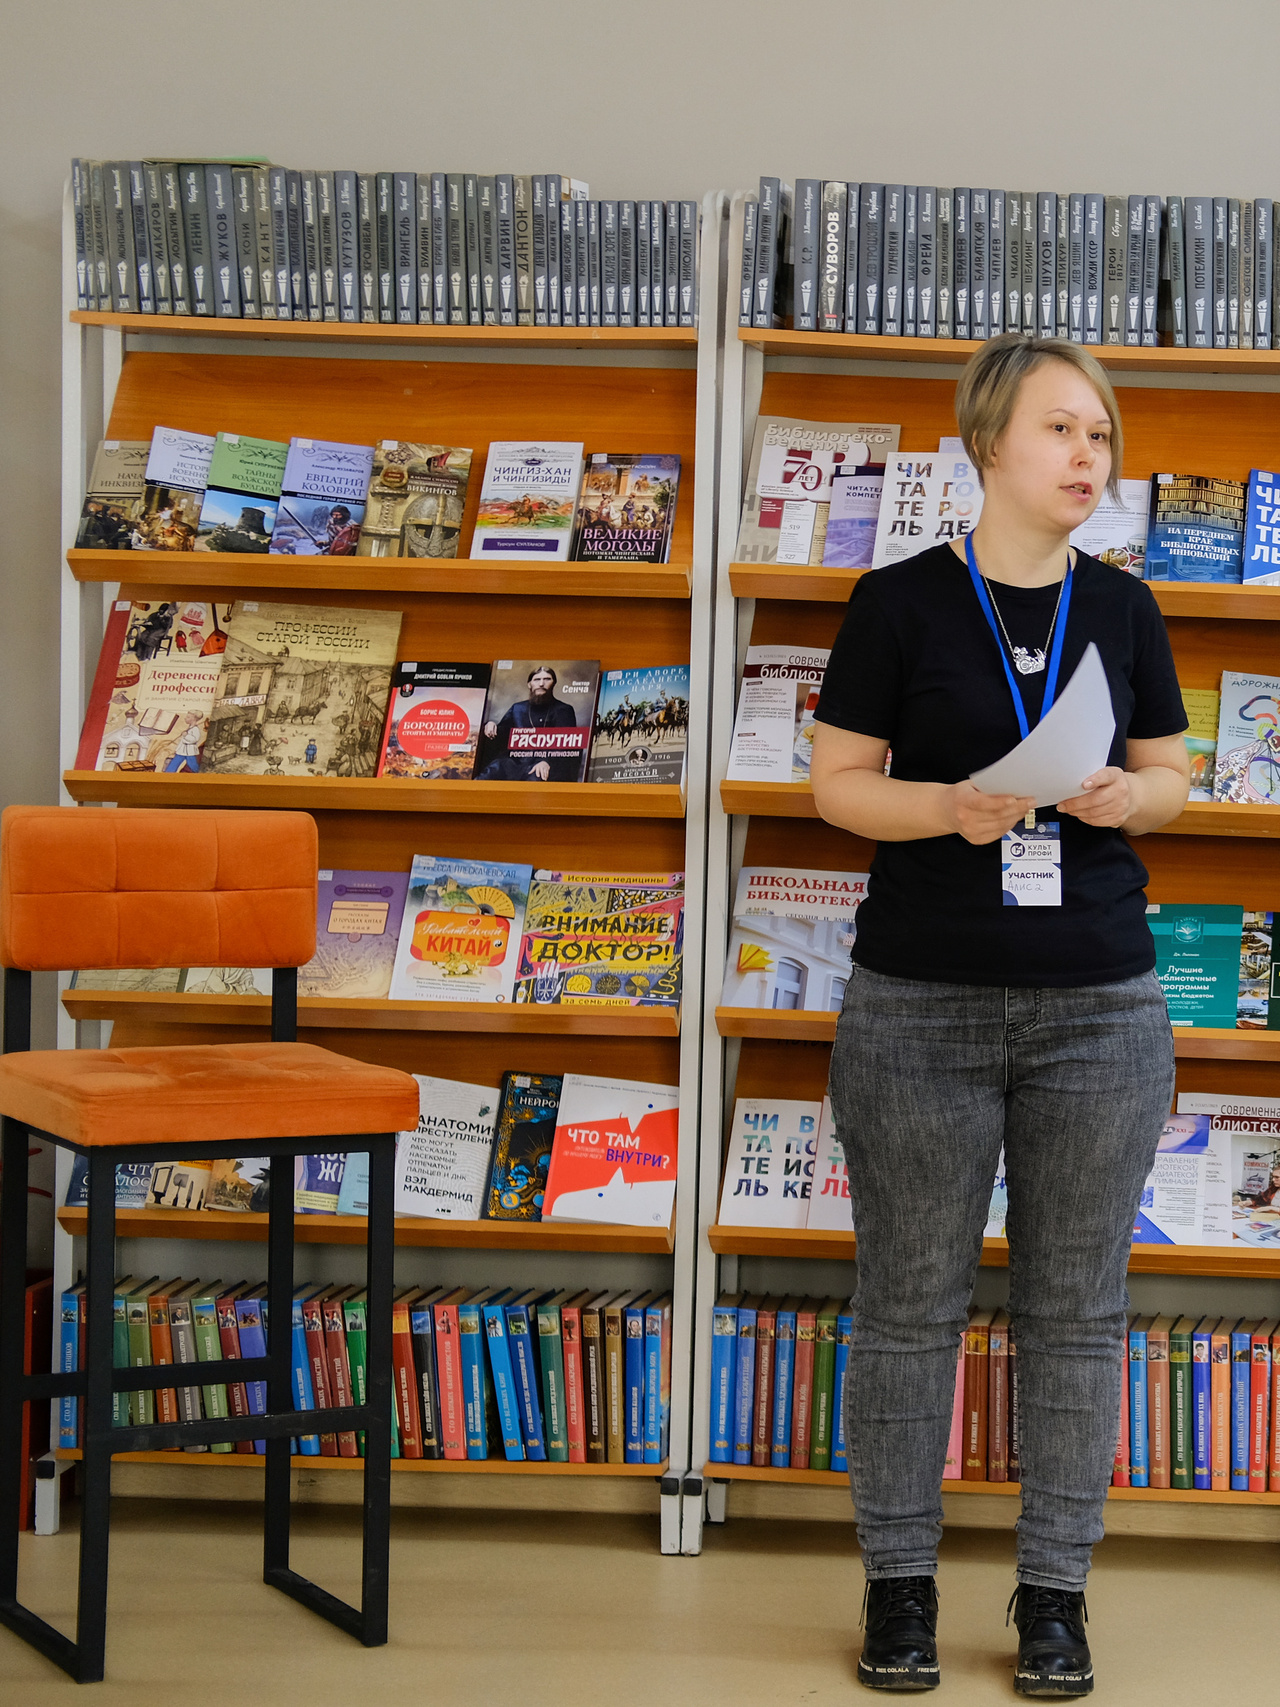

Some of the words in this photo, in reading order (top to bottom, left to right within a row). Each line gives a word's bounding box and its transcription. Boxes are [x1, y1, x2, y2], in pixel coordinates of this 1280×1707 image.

[151, 202, 164, 261] МАКАРОВ
[189, 213, 203, 255] ЛЕНИН
[217, 213, 229, 261] ЖУКОВ
[342, 212, 352, 268] КУТУЗОВ
[363, 221, 372, 271] КРОМВЕЛЬ
[400, 217, 410, 267] ВРАНГЕЛЬ
[421, 227, 429, 268] БУЛАВИН
[500, 219, 511, 269] ДАРВИН
[516, 210, 529, 273] ДАНТОН
[826, 212, 840, 284] СУВОРОВ
[1090, 240, 1098, 259] СССР
[640, 238, 648, 277] МЕЦЕНАТ
[921, 234, 932, 276] ФРЕЙД
[957, 238, 967, 283] БЕРДЯЕВ
[992, 238, 1002, 280] ЧАПАЕВ
[1010, 240, 1018, 278] ЧКАЛОВ
[1025, 239, 1034, 283] ШЕЛЛИНГ
[1042, 240, 1052, 286] ШУХОВ
[1059, 243, 1067, 285] ЭПИКУР
[1108, 248, 1117, 281] ГЕРОИ
[1195, 238, 1205, 289] ПОТЕМКИН
[1088, 261, 1097, 290] ВОЖДИ
[765, 434, 850, 452] ведение
[766, 424, 892, 444] Библиотеко-
[245, 468, 276, 478] ТАЙНЫ
[494, 467, 572, 475] ЧИНГИЗ-ХАН
[503, 475, 571, 484] ЧИНГИЗИДЫ
[783, 459, 823, 491] 70
[897, 462, 932, 478] ЧИ
[953, 462, 969, 478] В
[240, 482, 275, 493] БУЛГАРА
[302, 482, 365, 497] КОЛОВРАТ
[306, 473, 364, 487] ЕВПАТИЙ
[897, 481, 927, 497] ТА
[942, 482, 975, 497] ГО
[407, 485, 458, 496] ВИКИНГОВ
[895, 501, 924, 516] ТЕ
[938, 501, 973, 516] РО
[583, 528, 662, 541] ВЕЛИКИЕ
[888, 520, 924, 536] ЛЬ
[935, 520, 970, 539] ДЕ
[1183, 529, 1235, 541] ПЕРЕДНЕМ
[584, 540, 656, 551] МОГОЛЫ
[1160, 541, 1240, 555] БИБЛИОТЕЧНЫХ
[1188, 536, 1214, 545] КРАЕ
[1169, 548, 1231, 562] ИННОВАЦИЙ
[274, 621, 358, 636] ПРОФЕССИИ
[256, 632, 310, 645] СТАРОЙ
[316, 636, 370, 649] РОССИИ
[562, 685, 589, 694] Сенча
[631, 684, 663, 692] ЦАРЯ
[403, 721, 465, 731] БОРОДИНО
[510, 732, 583, 748] РАСПУТИН
[612, 875, 664, 884] медицины
[748, 876, 865, 893] ШКОЛЬНАЯ
[747, 891, 862, 906] БИБЛИОТЕКА
[540, 915, 675, 935] ВНИМАНИЕ,
[427, 935, 491, 957] КИТАЙ
[538, 943, 670, 962] ДОКТОР!
[1167, 965, 1203, 974] Лучшие
[744, 1114, 779, 1131] ЧИ
[799, 1116, 814, 1133] В
[429, 1140, 454, 1148] МОГУТ
[568, 1128, 600, 1144] ЧТО
[605, 1132, 641, 1149] ТАМ
[743, 1135, 772, 1153] ТА
[410, 1144, 458, 1156] РАССКАЗАТЬ
[606, 1149, 670, 1170] ВНУТРИ?
[741, 1157, 770, 1174] ТЕ
[405, 1175, 427, 1185] ВЭЛ
[733, 1179, 769, 1196] ЛЬ
[783, 1180, 812, 1199] КЕ
[403, 1184, 473, 1203] МАКДЕРМИД
